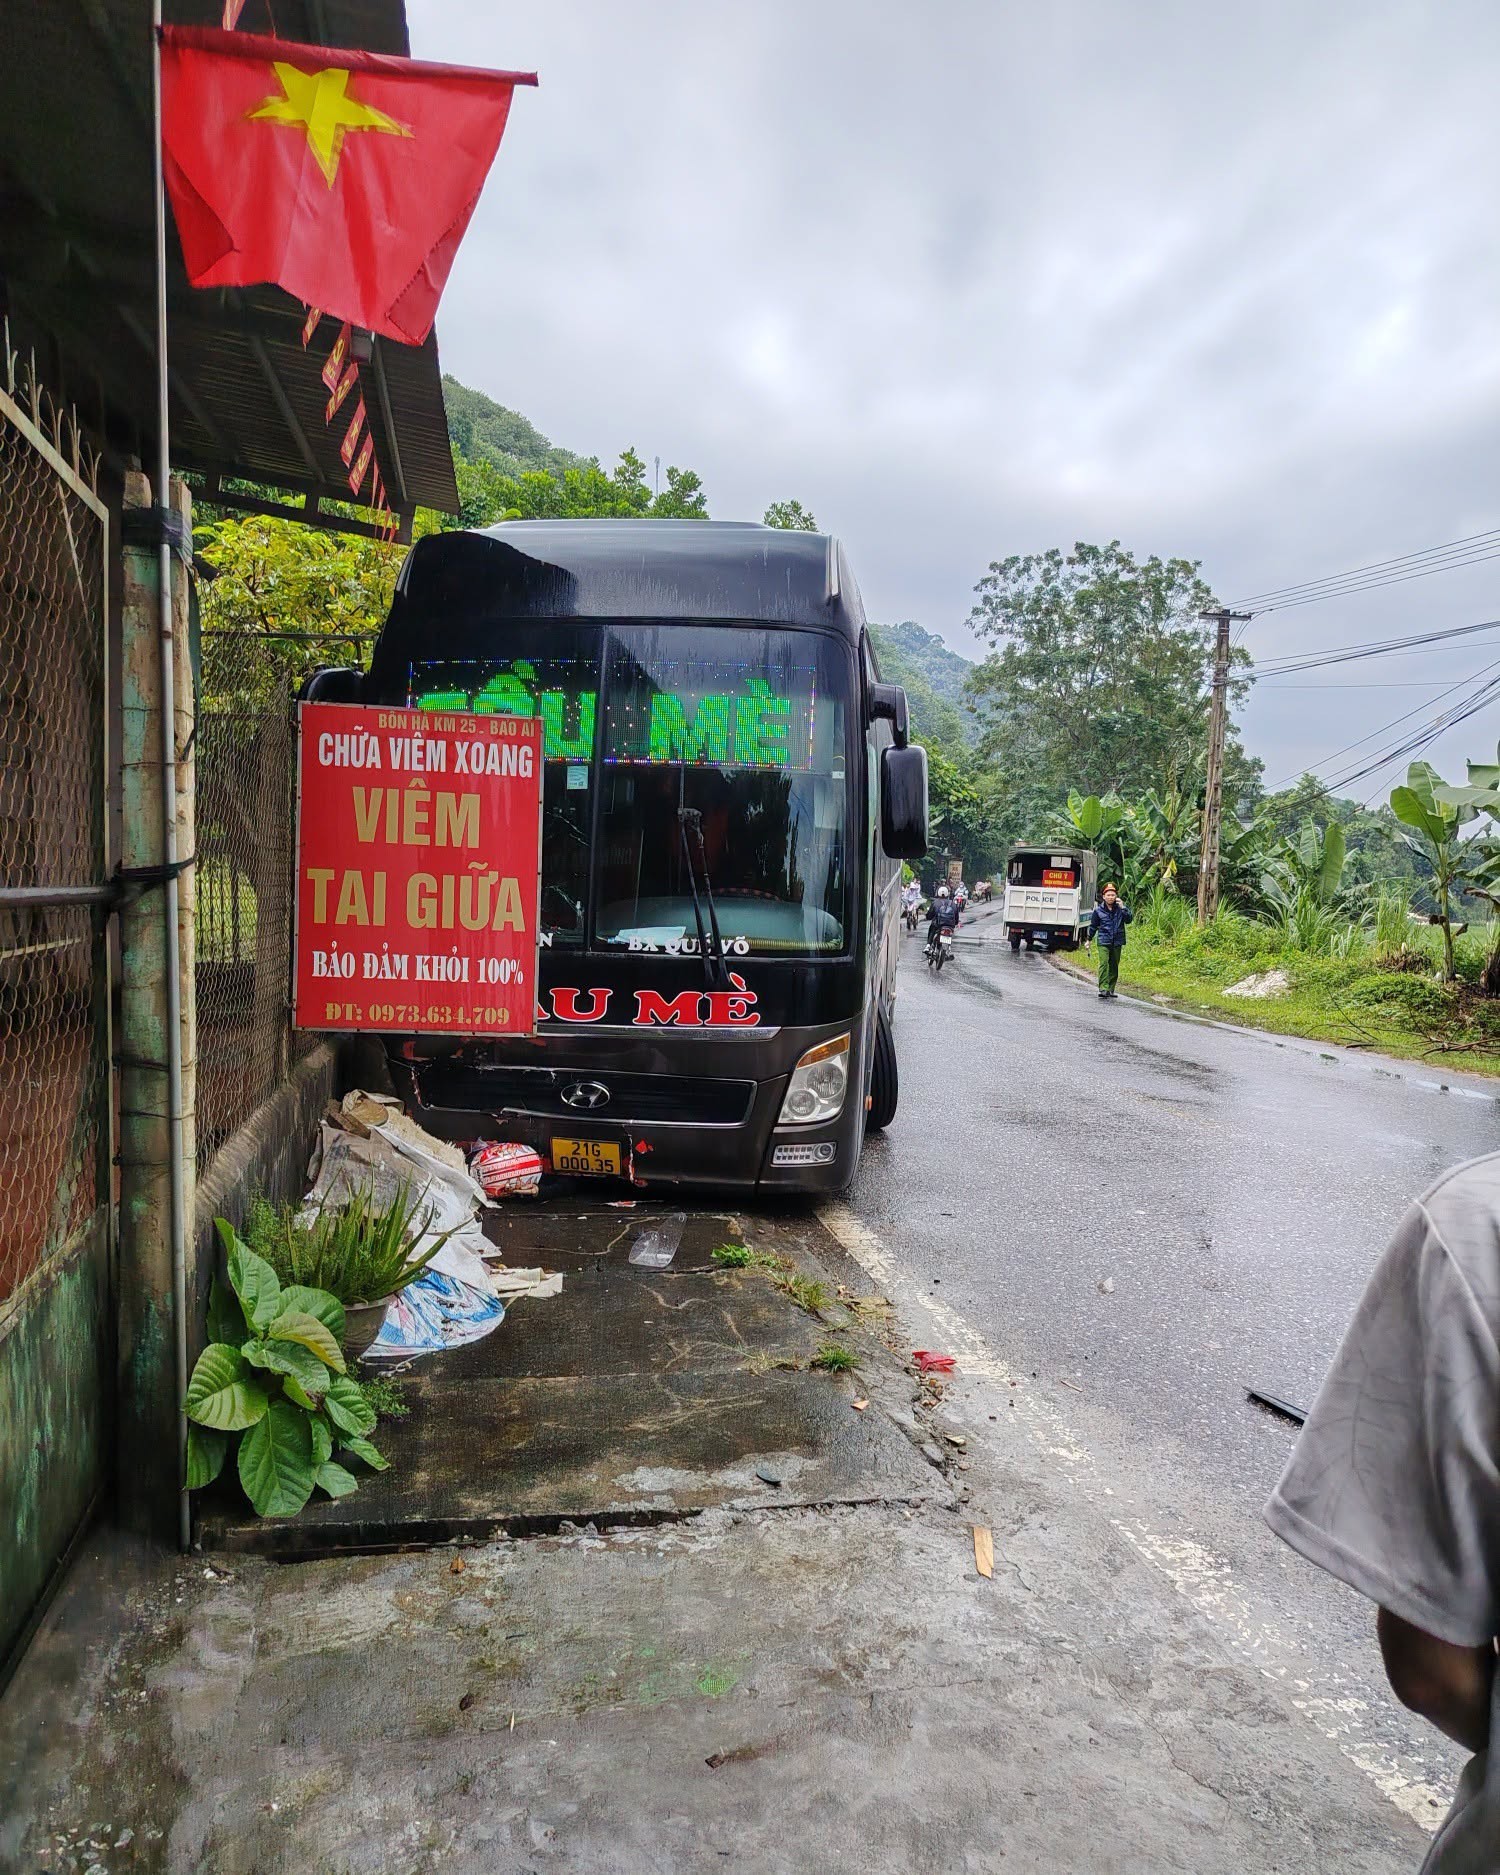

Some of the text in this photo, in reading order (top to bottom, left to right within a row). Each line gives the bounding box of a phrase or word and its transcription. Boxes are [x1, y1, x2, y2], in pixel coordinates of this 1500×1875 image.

[434, 717, 456, 733] KM
[649, 677, 791, 765] MÈ
[318, 725, 381, 769] CHỮA
[389, 731, 447, 773] VIÊM
[454, 740, 533, 778] XOANG
[352, 777, 481, 849] VIÊM
[307, 861, 526, 932] TAI GIỮA
[312, 940, 524, 985] BẢO ĐẢM KHỎI 100%
[628, 936, 659, 952] BX
[369, 1004, 510, 1025] 0973.634.709
[632, 972, 761, 1027] MÈ
[560, 1156, 614, 1173] 000.35
